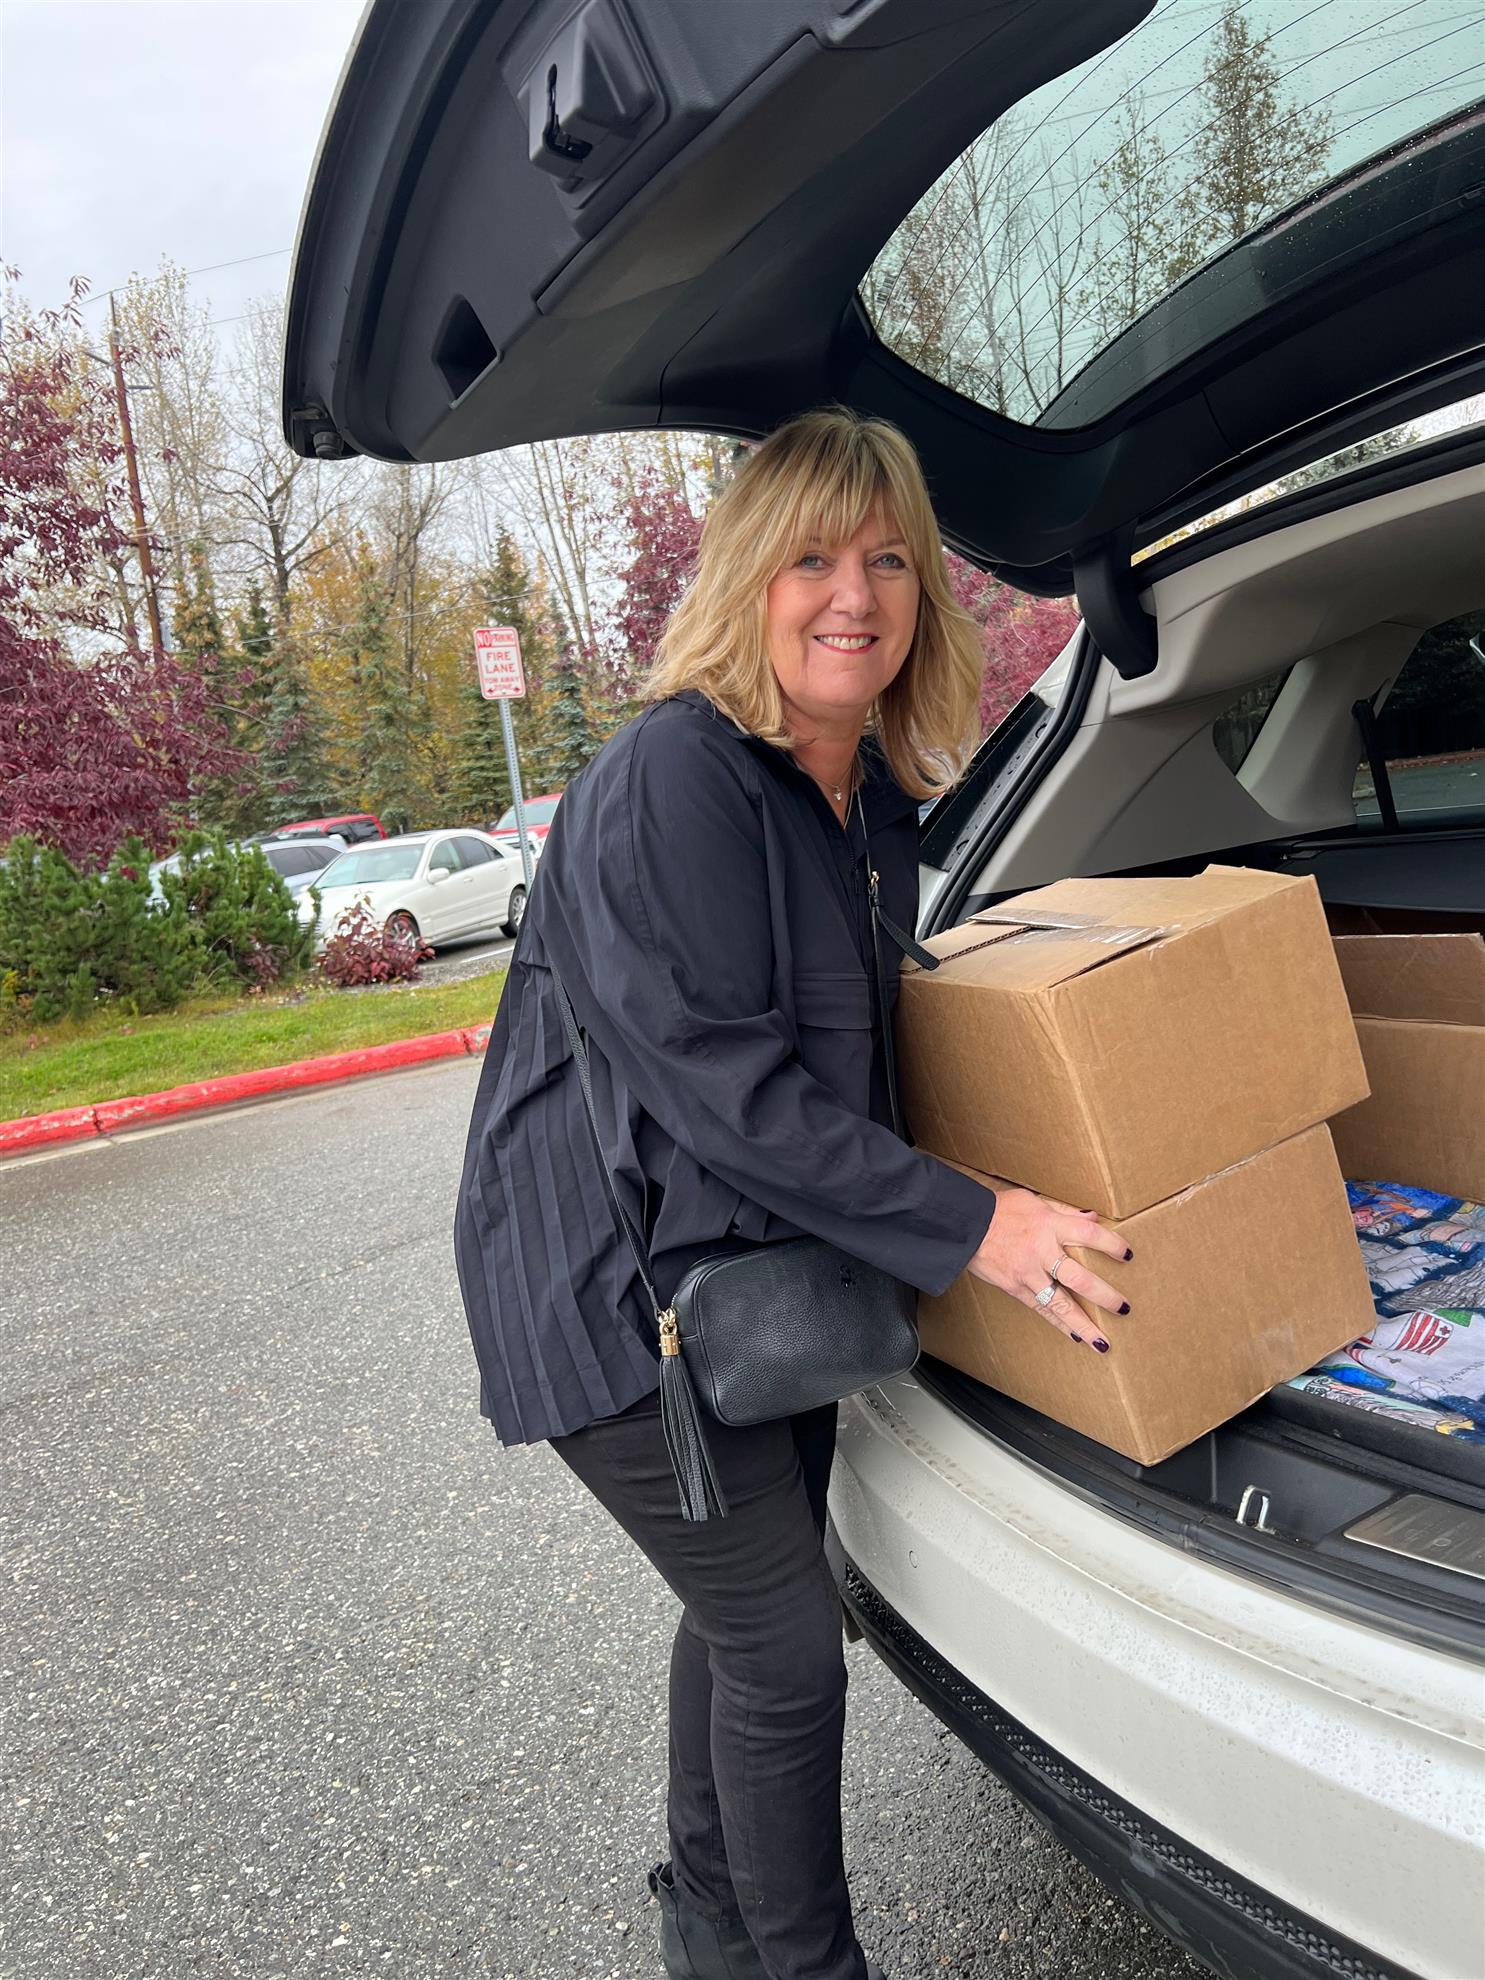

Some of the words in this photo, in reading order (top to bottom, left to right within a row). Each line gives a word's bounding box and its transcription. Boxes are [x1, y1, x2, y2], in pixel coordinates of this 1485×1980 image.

[477, 631, 492, 646] NO
[486, 651, 511, 661] FIRE
[485, 663, 515, 673] LANE
